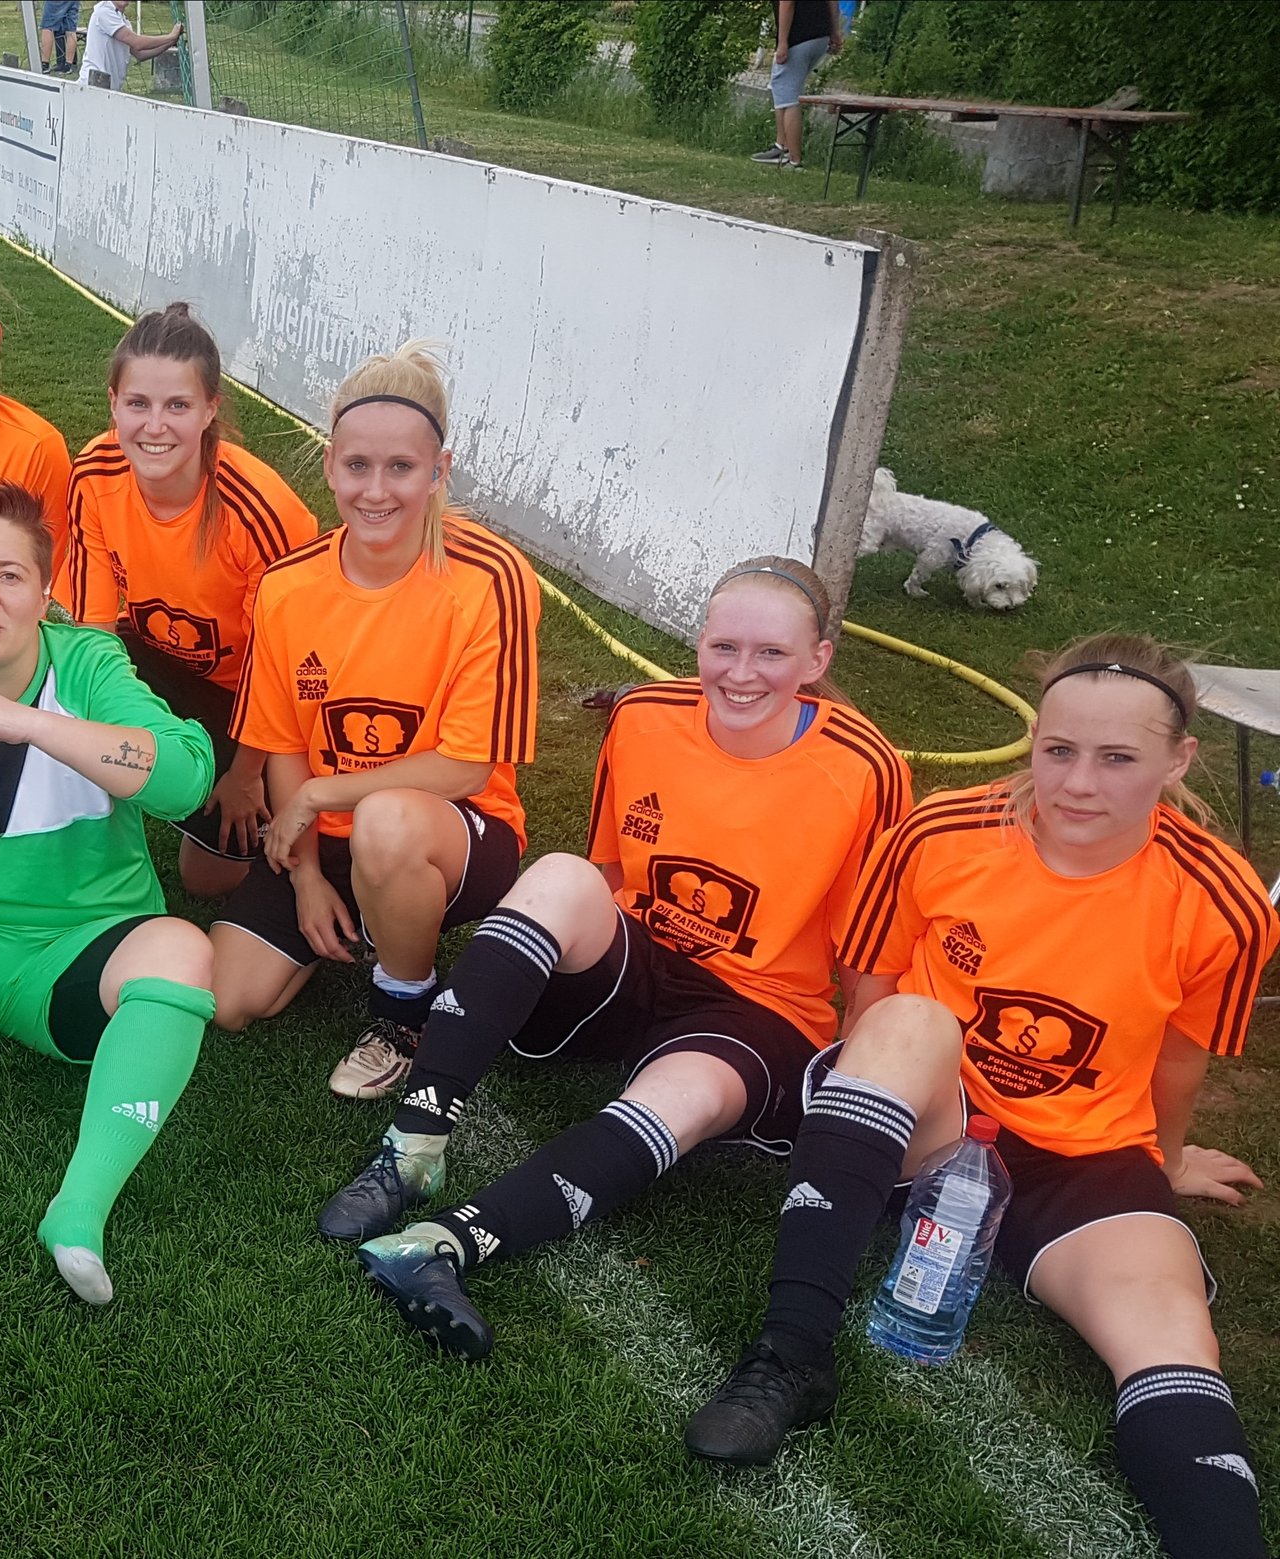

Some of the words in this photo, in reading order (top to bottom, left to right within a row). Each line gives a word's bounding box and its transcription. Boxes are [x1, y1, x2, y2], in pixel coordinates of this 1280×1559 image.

[296, 666, 328, 676] adidas
[297, 679, 329, 691] SC24
[629, 803, 664, 821] adidas
[624, 814, 661, 836] SC24
[655, 904, 674, 917] DIE
[672, 913, 731, 945] PATENTERIE
[949, 927, 987, 952] adidas
[942, 935, 983, 968] SC24
[1023, 1068, 1042, 1080] und
[403, 1096, 443, 1116] adidas
[111, 1105, 159, 1133] adidas
[552, 1173, 581, 1230] adidas
